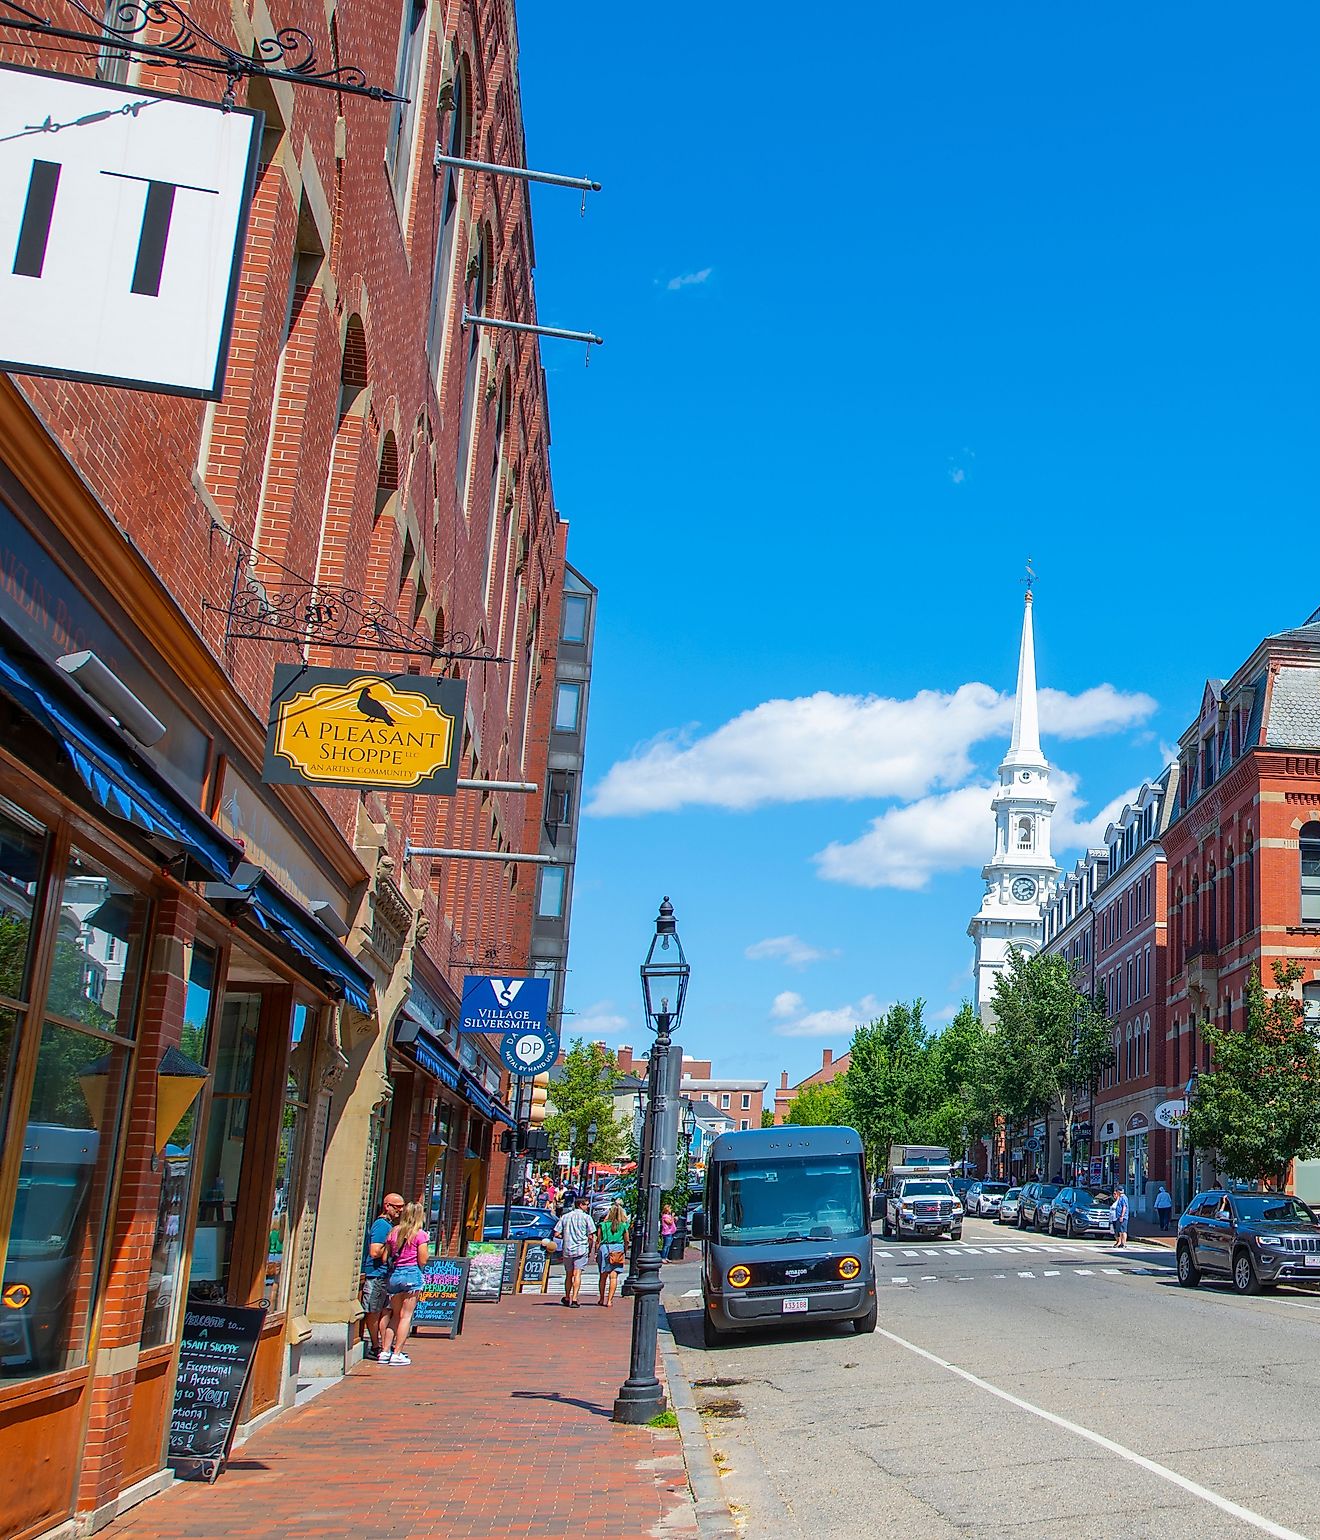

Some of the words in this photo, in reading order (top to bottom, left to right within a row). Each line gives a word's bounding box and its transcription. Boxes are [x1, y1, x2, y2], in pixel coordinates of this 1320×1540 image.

[292, 721, 310, 739] A
[319, 722, 441, 748] PLEASANT
[320, 743, 403, 765] SHOPPE
[310, 764, 324, 772] AN
[326, 765, 355, 774] ARTIST
[357, 767, 414, 778] COMMUNITY
[478, 1008, 530, 1020] VILLAGE
[463, 1018, 541, 1030] SILVERSMITH
[521, 1042, 542, 1055] DP
[505, 1051, 518, 1068] METAL
[528, 1062, 546, 1072] HAND
[545, 1051, 555, 1063] USA
[433, 1260, 456, 1268] VILLAGE
[525, 1261, 544, 1273] OPEN
[785, 1269, 807, 1277] amazon
[199, 1329, 208, 1338] A
[181, 1339, 208, 1351] ASANT
[210, 1342, 241, 1354] SHOPPE
[186, 1360, 232, 1375] Exceptional
[190, 1372, 220, 1386] Artists
[184, 1388, 195, 1399] to
